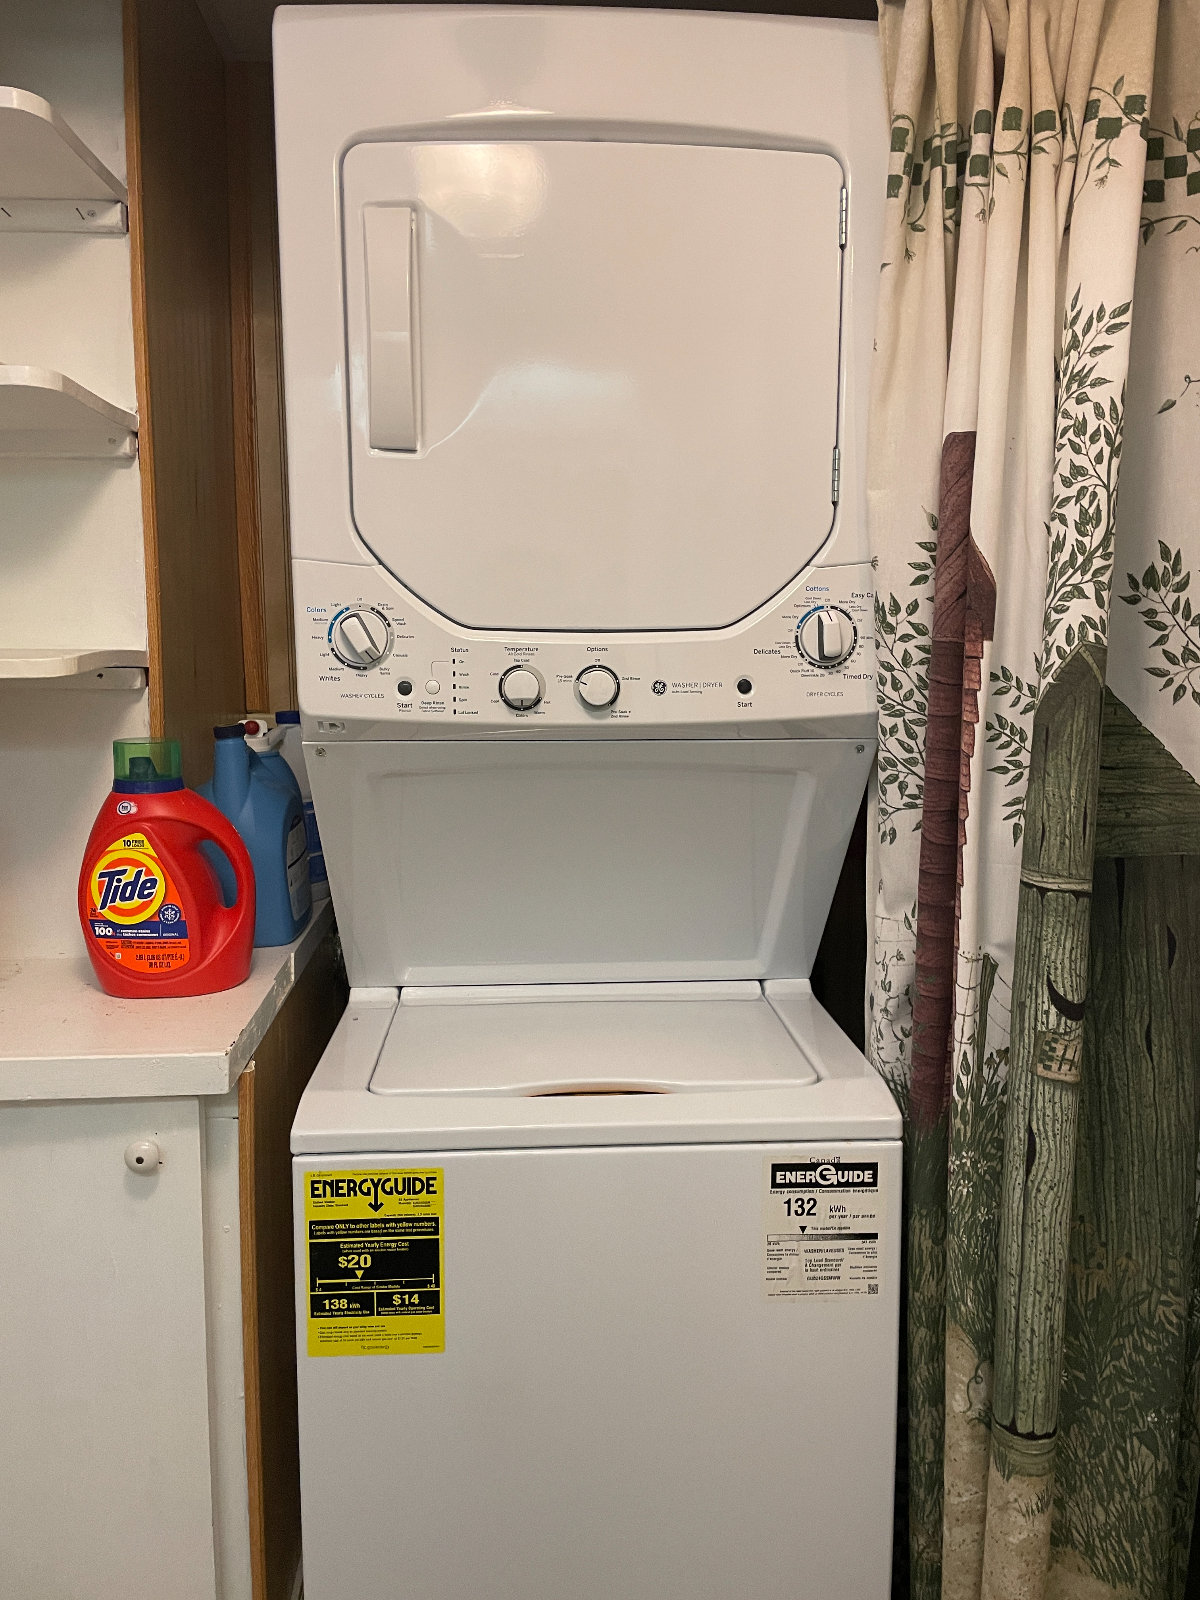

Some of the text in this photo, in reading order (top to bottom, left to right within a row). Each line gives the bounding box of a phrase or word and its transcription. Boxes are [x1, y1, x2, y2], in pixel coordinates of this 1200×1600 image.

[861, 673, 874, 681] Dry
[122, 839, 132, 848] 10
[97, 866, 159, 912] Tide
[809, 1156, 841, 1164] Canada
[775, 1164, 874, 1186] ENERGUIDE
[310, 1176, 438, 1199] ENERGYGUIDE
[783, 1197, 817, 1217] 132
[829, 1204, 847, 1213] kWh
[396, 1221, 413, 1229] yellow
[379, 1241, 398, 1249] Energy
[337, 1253, 372, 1269] $20
[808, 1261, 835, 1269] Chargement
[322, 1298, 348, 1310] 138
[392, 1293, 420, 1306] $14
